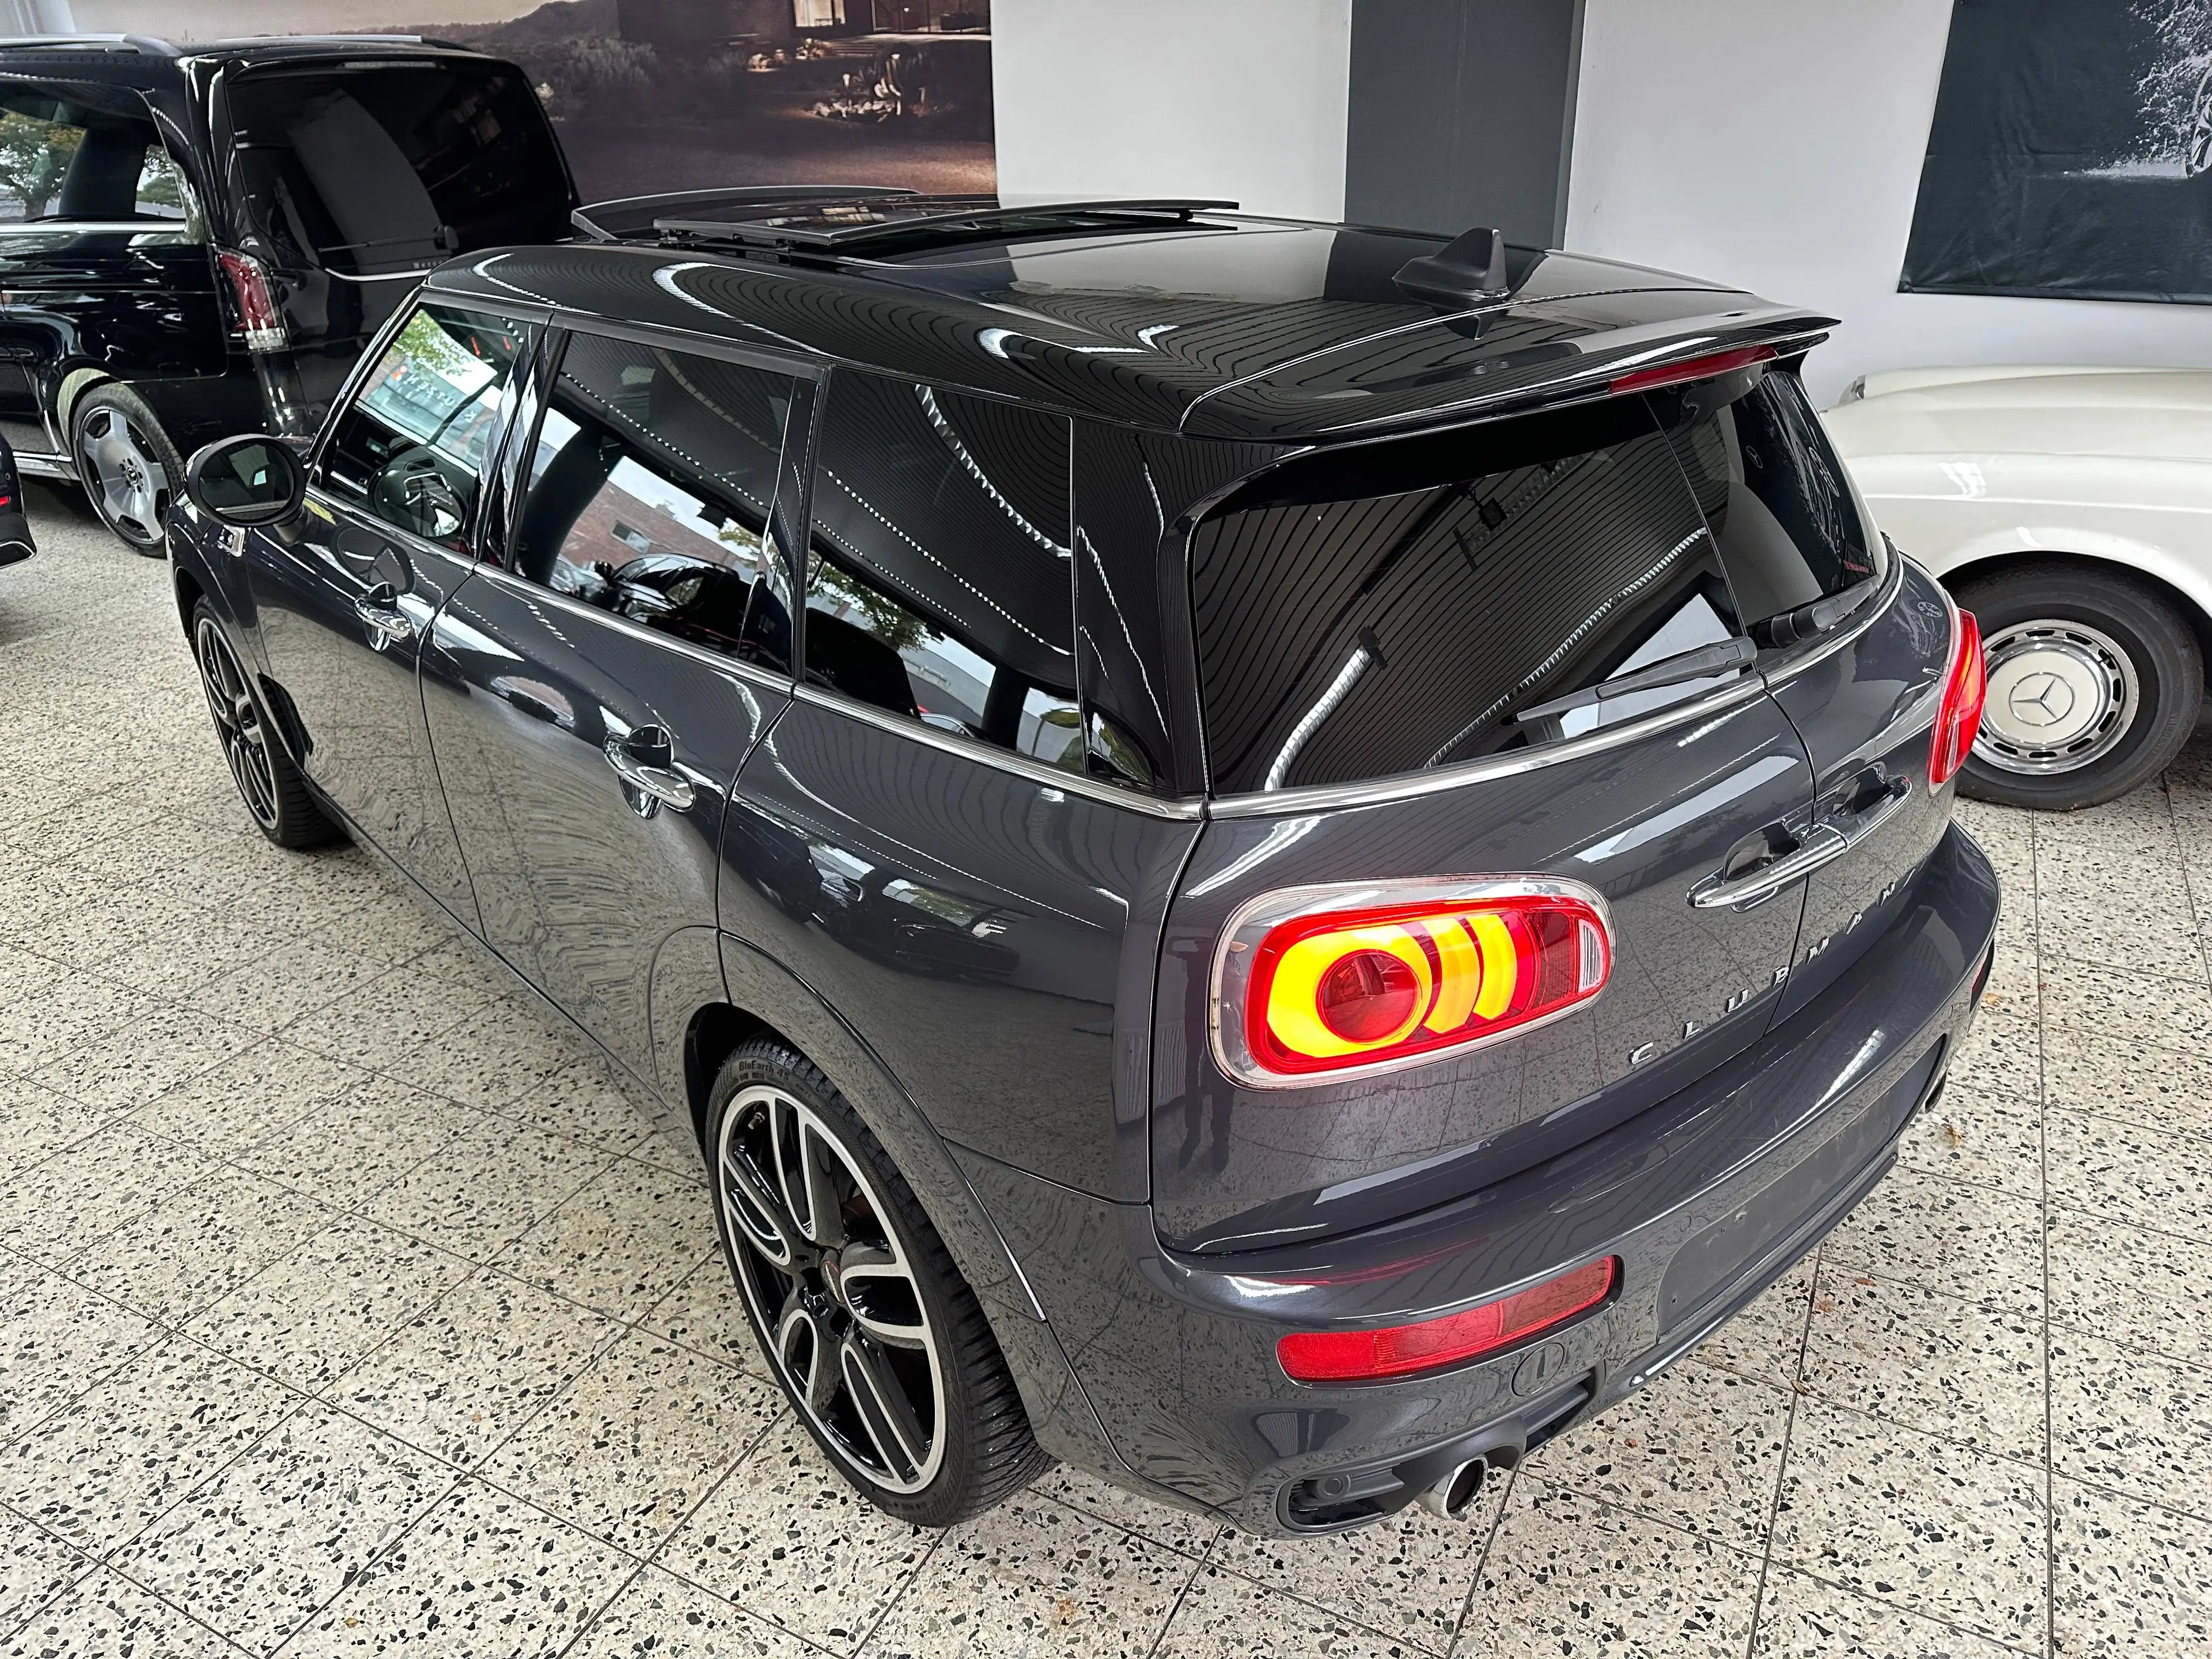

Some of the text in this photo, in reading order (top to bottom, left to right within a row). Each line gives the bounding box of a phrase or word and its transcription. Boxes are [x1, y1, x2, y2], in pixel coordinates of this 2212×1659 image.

[1628, 881, 1896, 1065] CLUBMAN
[738, 1059, 774, 1074] BluEarth
[777, 1069, 790, 1081] 4S
